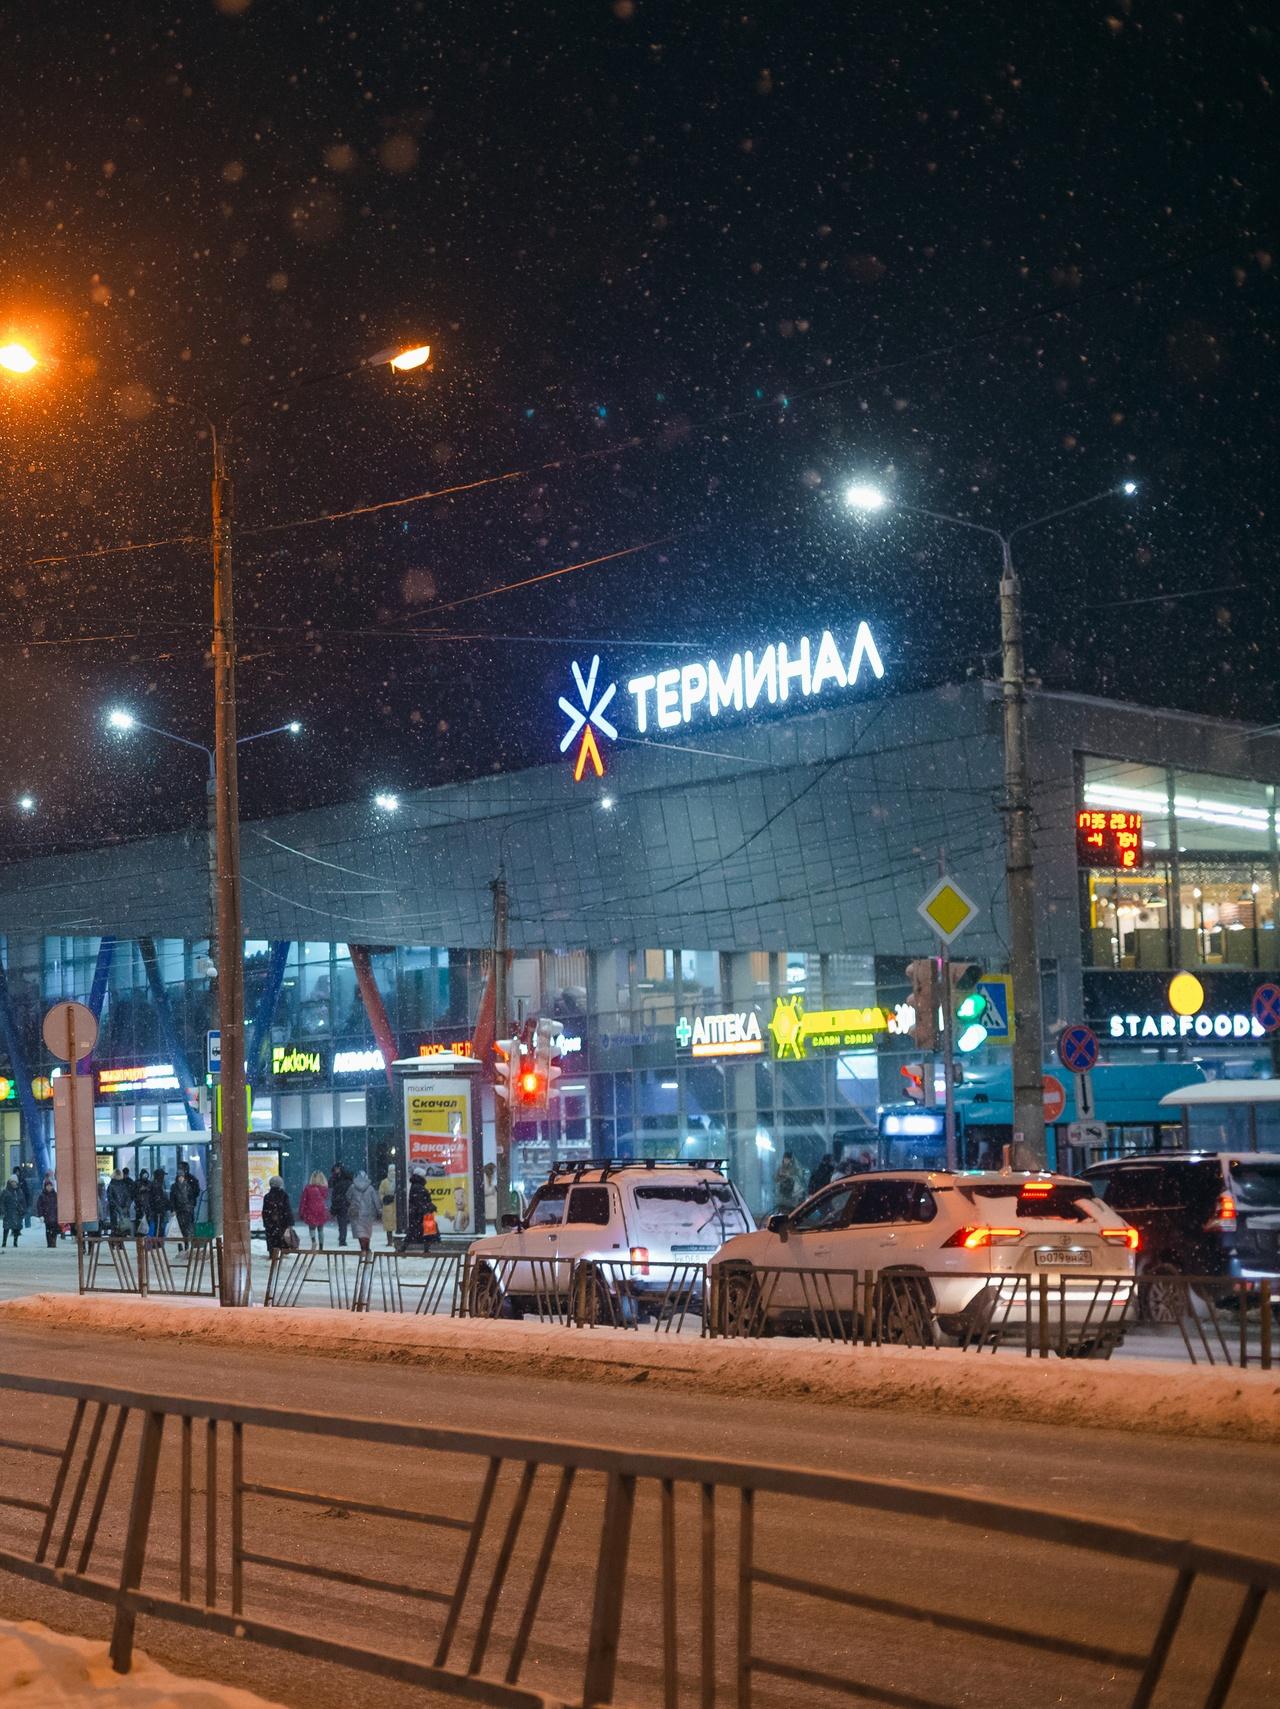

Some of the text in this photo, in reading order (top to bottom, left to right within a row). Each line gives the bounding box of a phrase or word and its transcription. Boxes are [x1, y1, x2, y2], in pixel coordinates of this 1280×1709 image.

[627, 620, 885, 733] ТЕРМИНАЛ
[691, 1012, 762, 1044] АПТЕКА
[408, 1084, 433, 1092] maxim
[412, 1098, 458, 1108] Скачал
